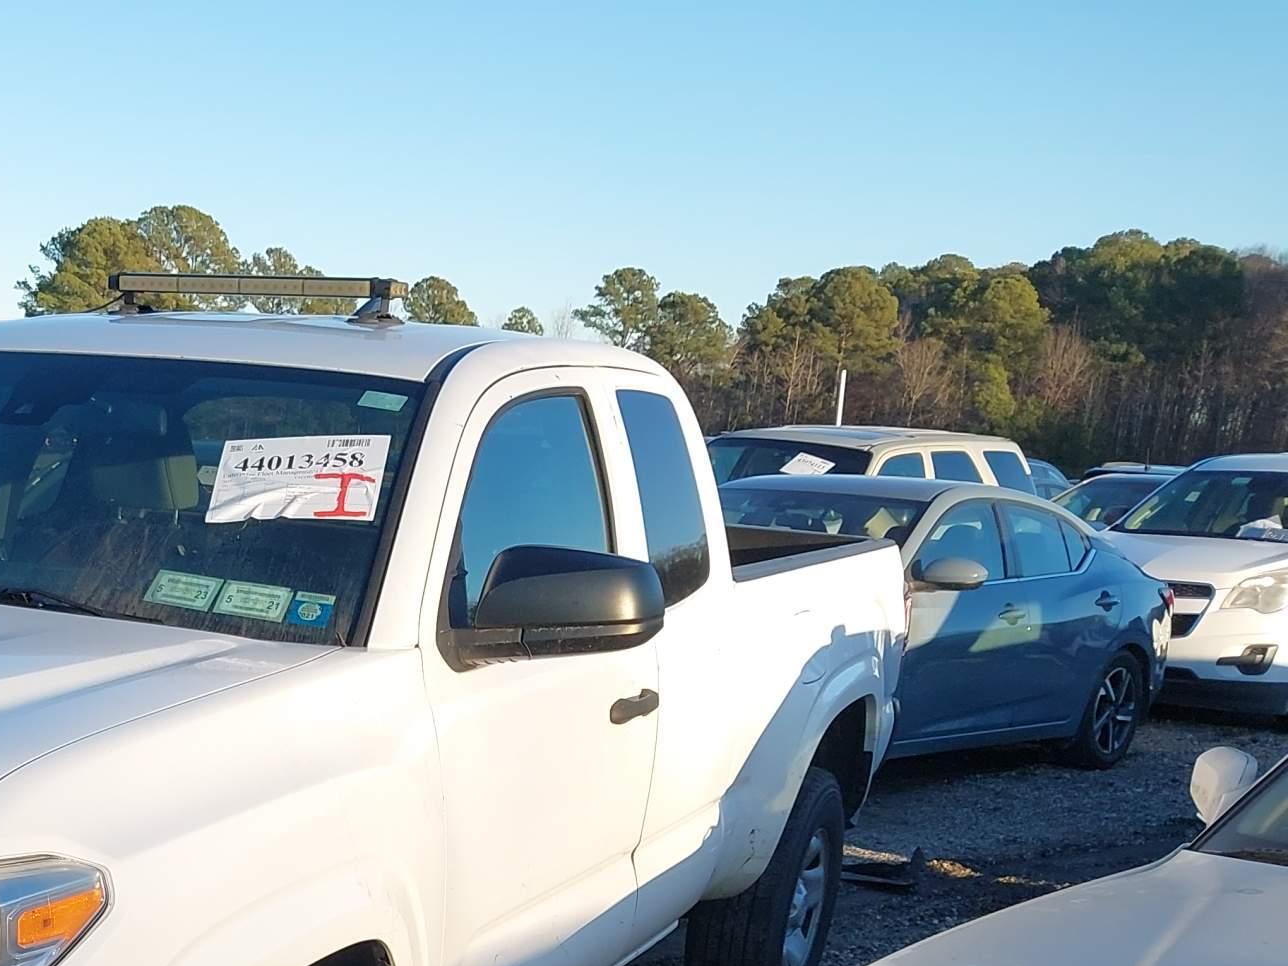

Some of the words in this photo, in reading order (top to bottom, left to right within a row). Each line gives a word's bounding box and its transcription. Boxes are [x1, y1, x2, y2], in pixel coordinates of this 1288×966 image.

[234, 452, 365, 472] 44013458
[194, 590, 209, 600] 23
[225, 595, 234, 603] 5
[266, 600, 280, 610] 21
